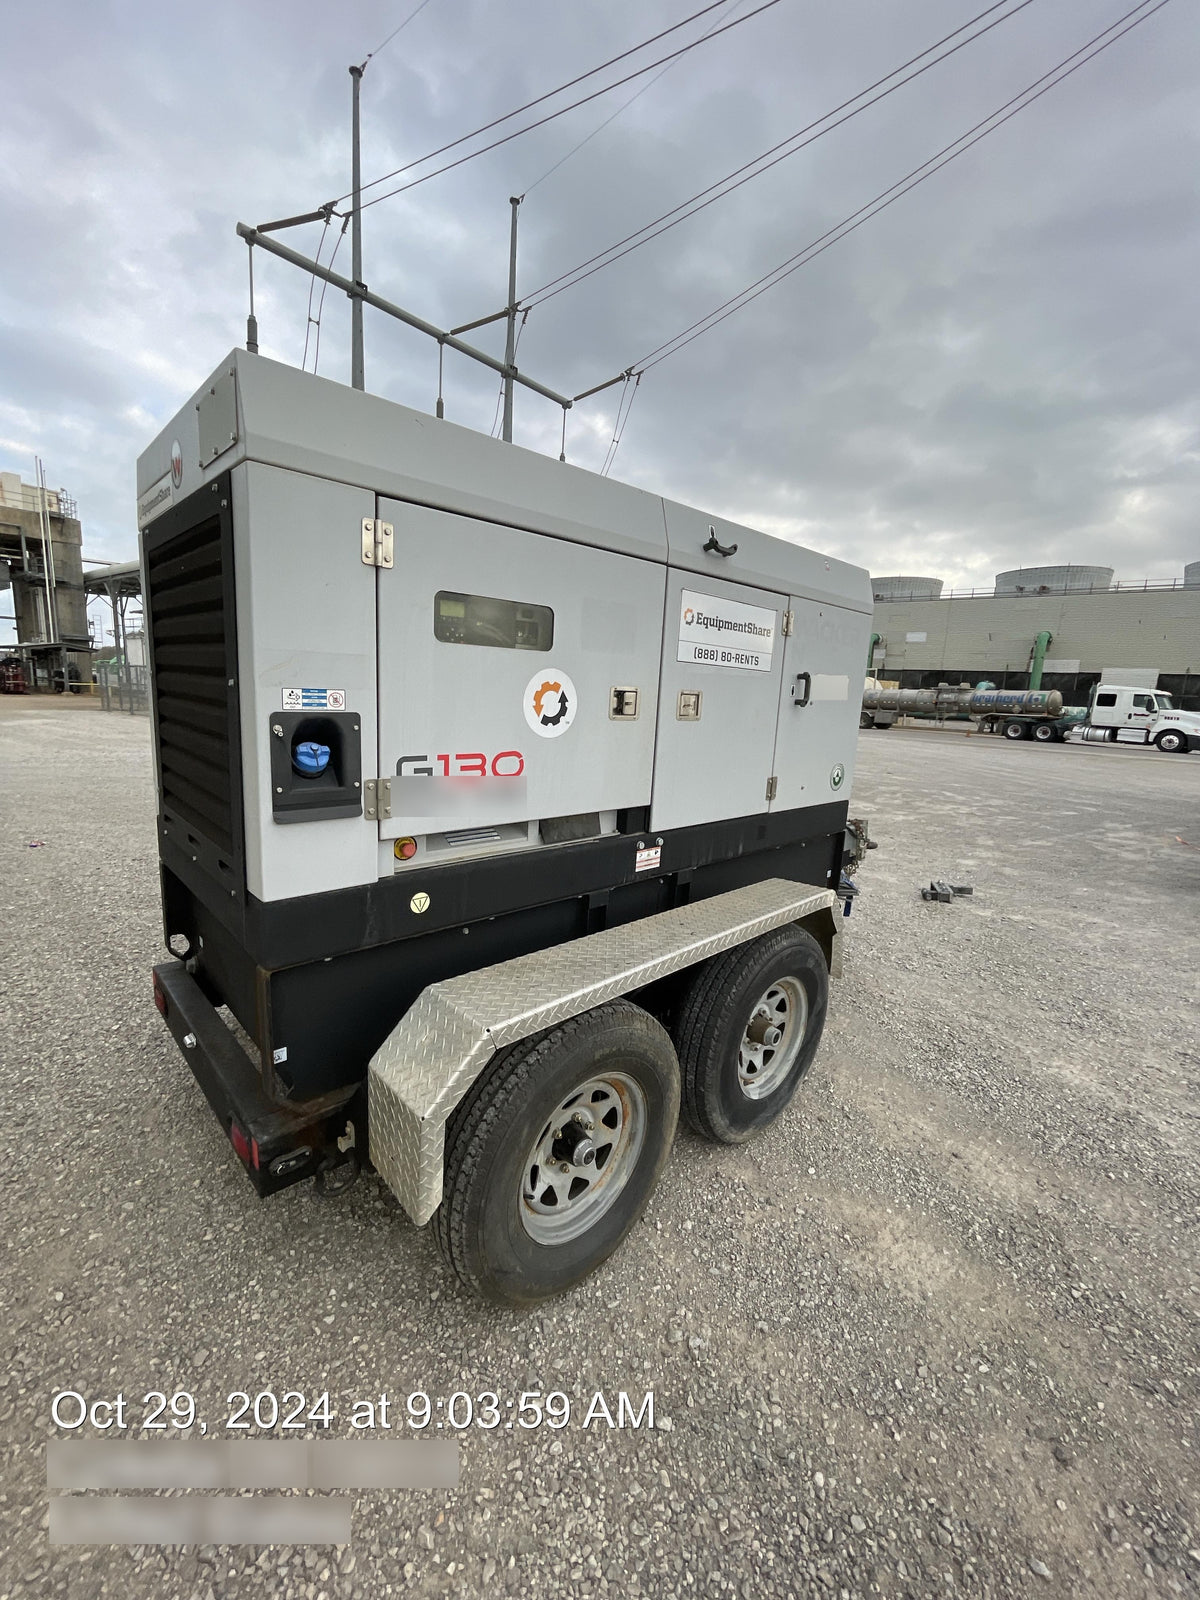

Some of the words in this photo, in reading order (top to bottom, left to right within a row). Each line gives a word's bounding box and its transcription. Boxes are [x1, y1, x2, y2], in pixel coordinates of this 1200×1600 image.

[696, 612, 771, 637] EquipmentShare
[694, 647, 718, 661] (888)
[721, 652, 759, 665] 80-RENTS
[395, 750, 525, 777] G130
